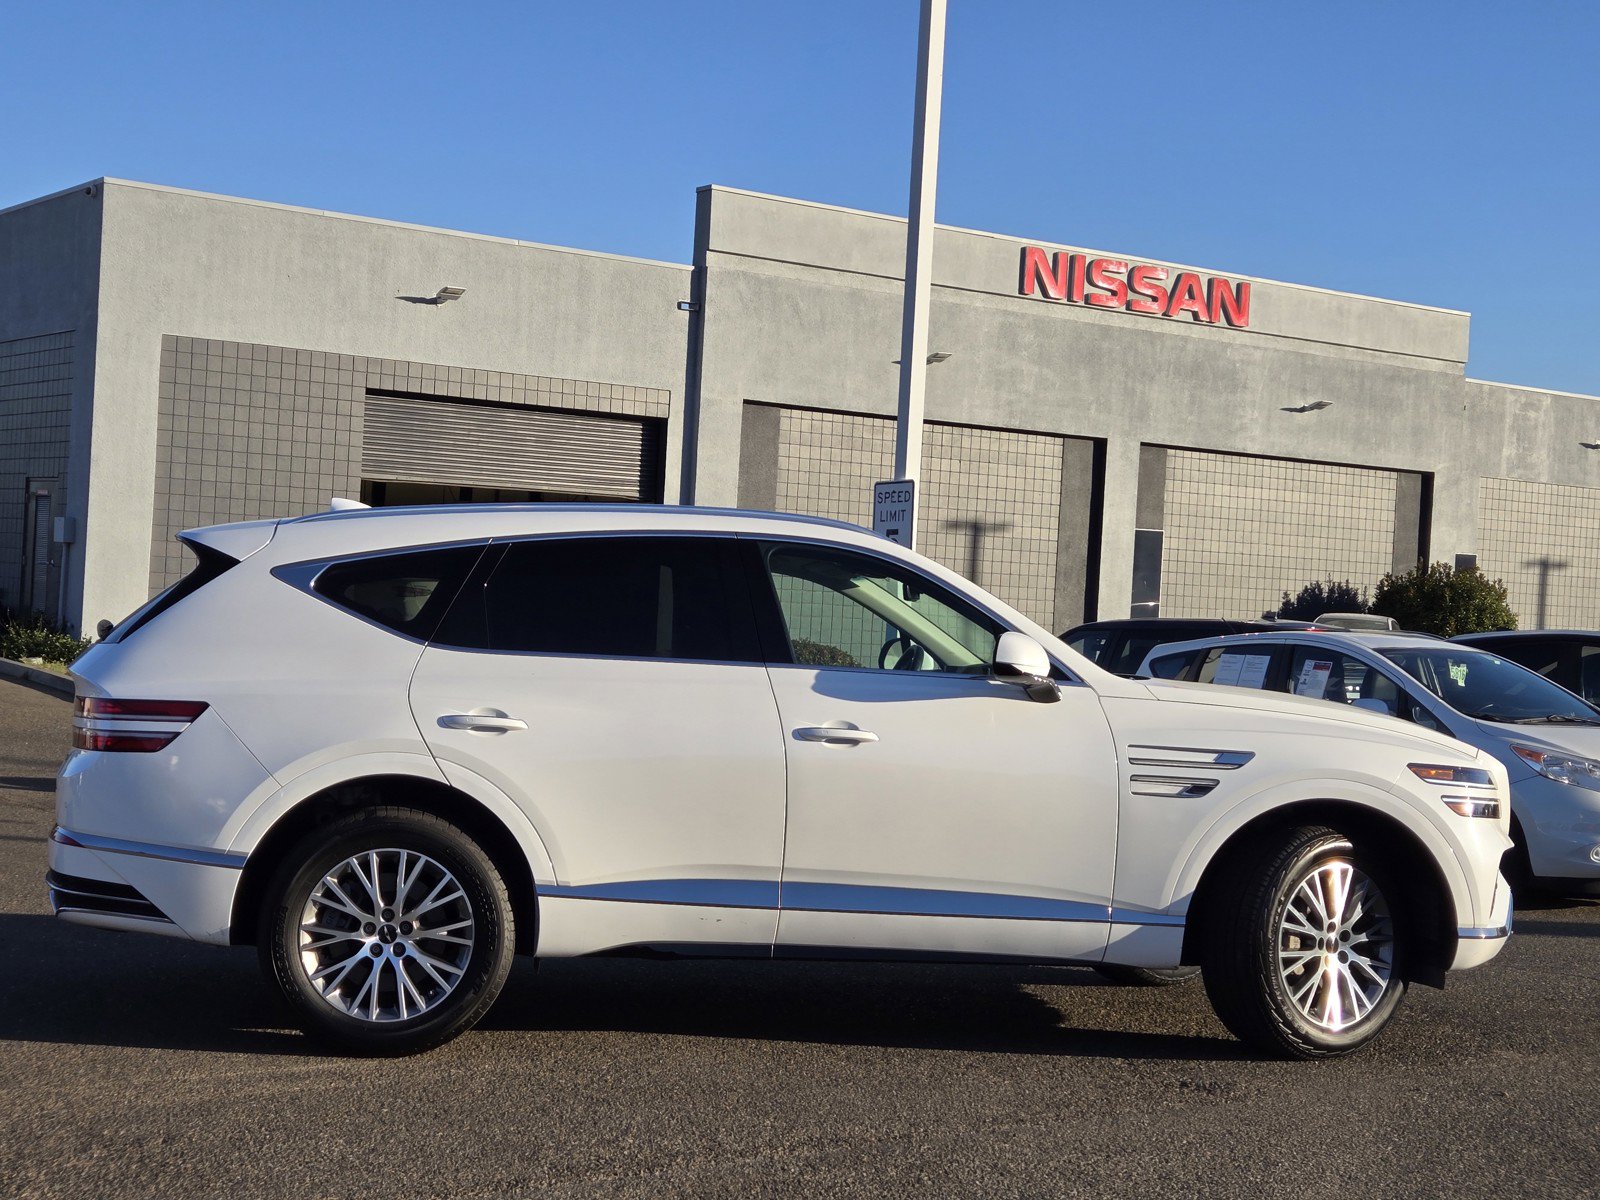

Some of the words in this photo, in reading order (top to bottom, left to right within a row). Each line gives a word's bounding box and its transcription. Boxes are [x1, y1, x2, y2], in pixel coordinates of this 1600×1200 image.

[1018, 246, 1251, 327] NISSAN
[877, 490, 911, 504] SPEED
[880, 509, 906, 522] LIMIT
